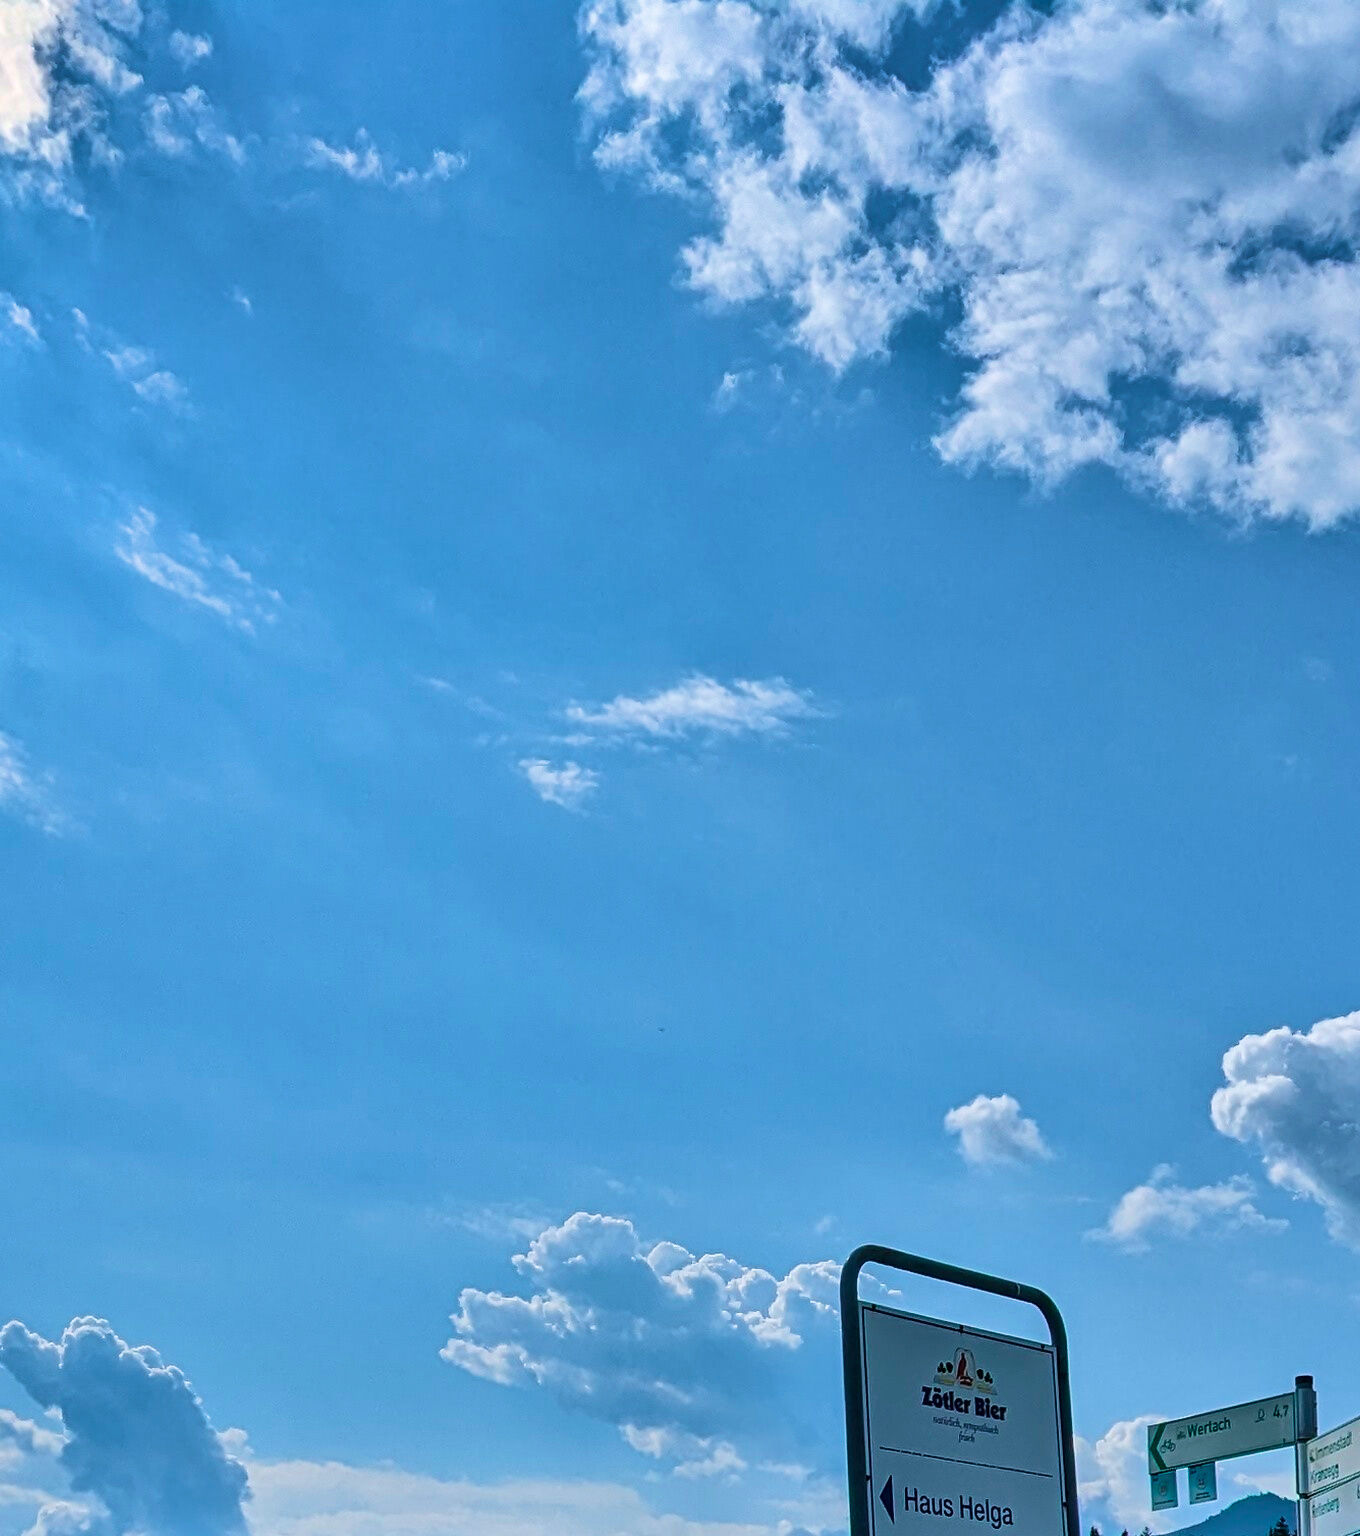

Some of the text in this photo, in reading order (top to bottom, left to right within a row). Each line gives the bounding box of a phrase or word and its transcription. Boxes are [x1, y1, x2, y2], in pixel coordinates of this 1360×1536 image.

[921, 1386, 1007, 1421] Zötler Bier
[1186, 1416, 1232, 1438] Wertach
[904, 1486, 1014, 1530] Haus Helga
